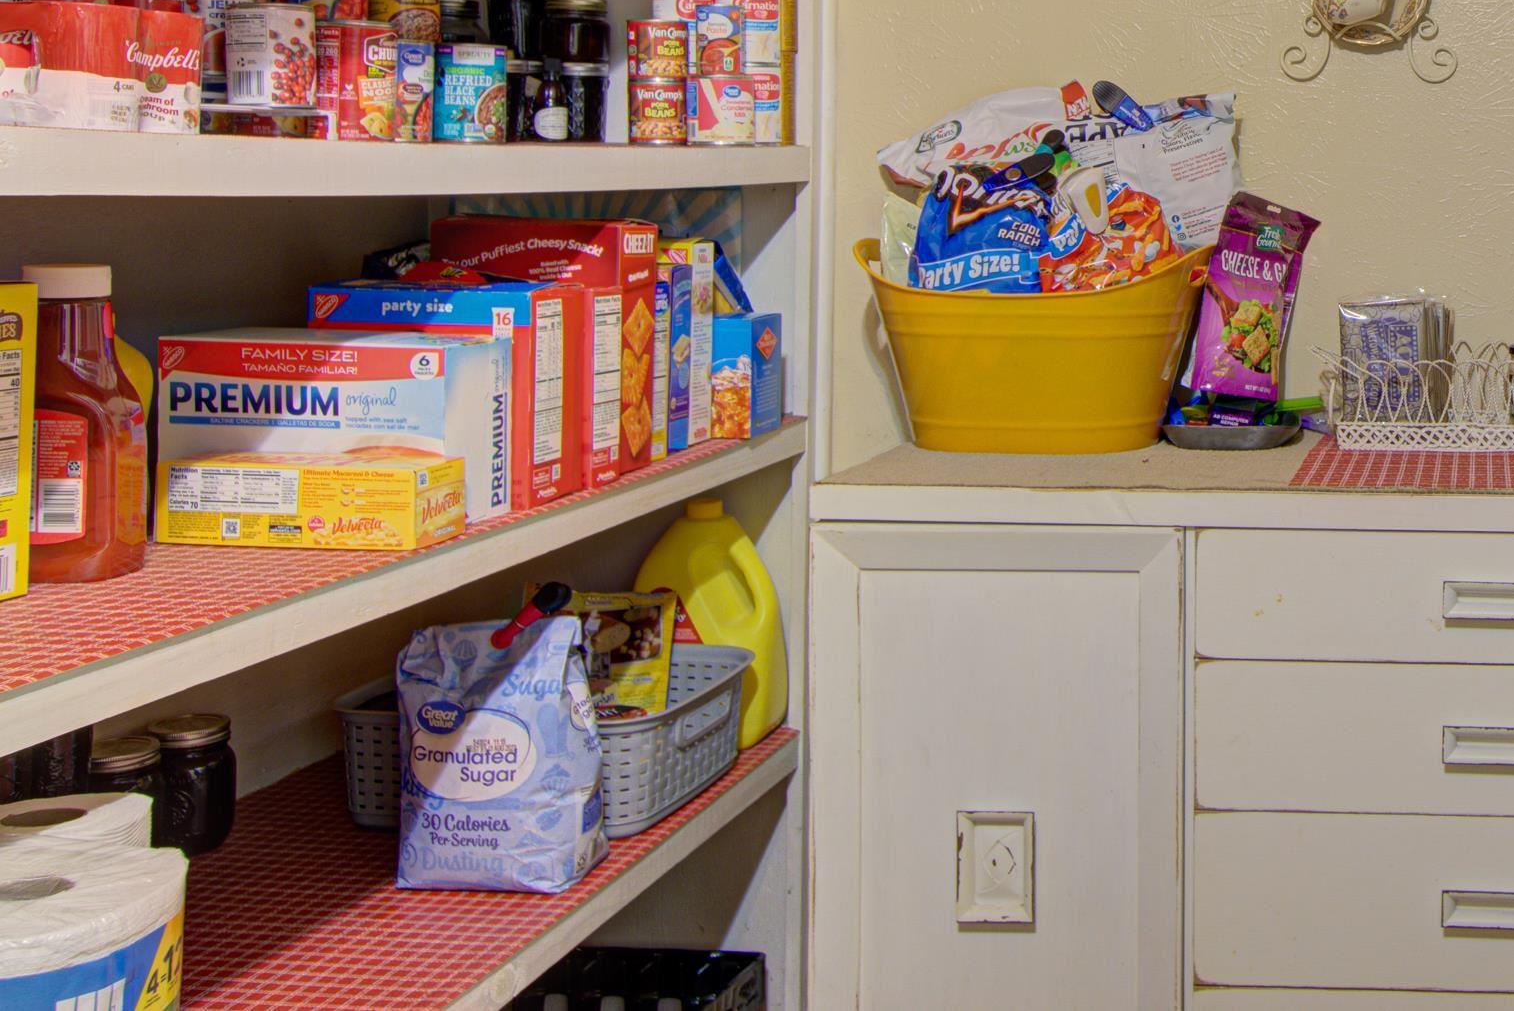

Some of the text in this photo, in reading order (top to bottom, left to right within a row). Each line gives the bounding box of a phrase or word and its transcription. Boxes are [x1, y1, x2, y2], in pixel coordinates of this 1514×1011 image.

[445, 74, 492, 86] REFRIED
[444, 85, 475, 96] BLACK
[444, 95, 476, 106] BEANS
[997, 228, 1041, 247] RANCH
[1012, 221, 1041, 238] COOL
[481, 242, 526, 263] Puffiest
[527, 238, 568, 251] Cheesy
[568, 239, 604, 257] Snack!
[918, 254, 1020, 289] Party Size!
[1221, 249, 1273, 281] CHEESE &
[381, 298, 454, 317] party size
[495, 312, 512, 326] 16
[241, 347, 358, 363] FAMILY SIZE!
[418, 355, 430, 367] 6
[242, 361, 358, 375] TAMAÑO FAMILIAR!
[169, 381, 340, 417] PREMIUM
[345, 386, 397, 416] original
[491, 393, 504, 508] PREMIUM
[190, 501, 199, 510] 70
[421, 489, 463, 525] Velveeta
[331, 517, 385, 536] Velveeta
[421, 706, 459, 721] Great
[428, 717, 454, 728] Value
[413, 745, 518, 766] Granulated
[459, 766, 517, 787] Sugar
[421, 812, 512, 833] 30 Calories
[429, 832, 500, 851] Per Serving
